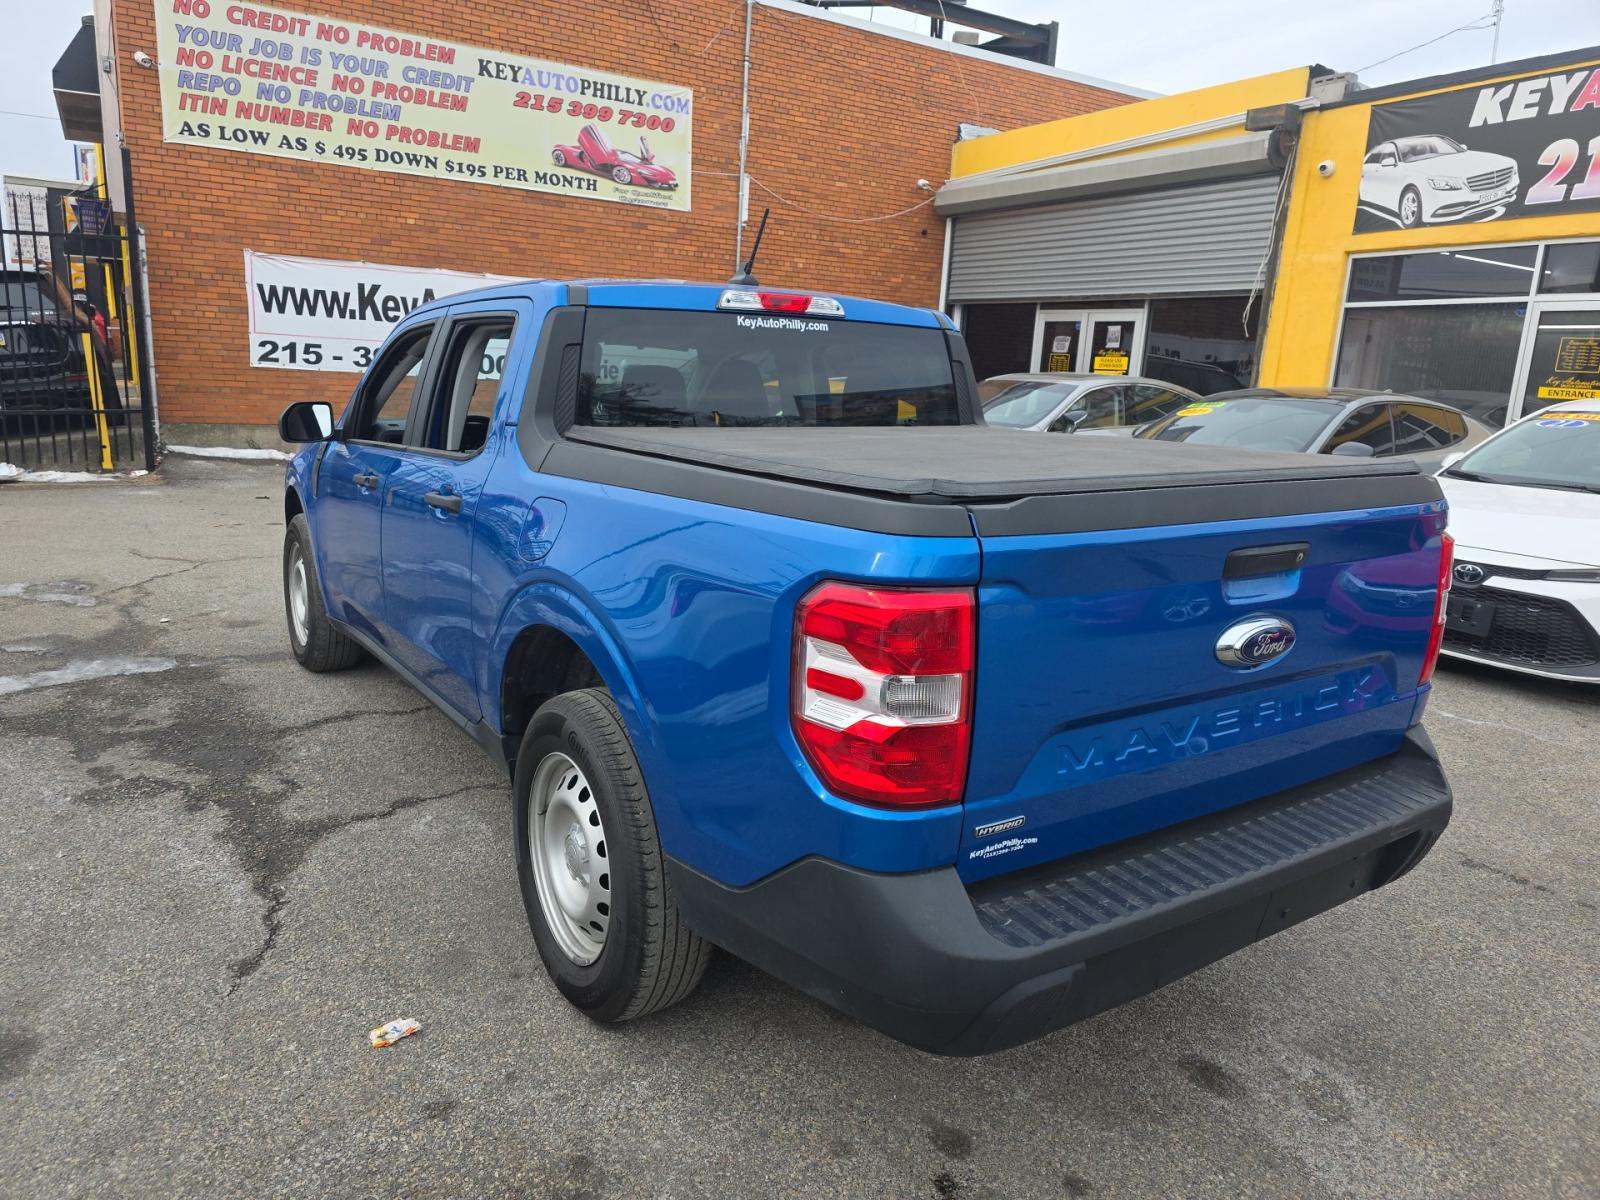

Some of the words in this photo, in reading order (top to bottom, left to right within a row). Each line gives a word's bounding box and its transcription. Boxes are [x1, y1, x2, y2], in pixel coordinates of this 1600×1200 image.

[173, 0, 210, 18] NO
[226, 6, 310, 36] CREDIT
[316, 23, 349, 44] NO
[357, 30, 455, 64] PROBLEM
[175, 24, 243, 52] YOUR
[249, 38, 293, 61] JOB
[301, 47, 322, 66] IS
[330, 52, 389, 78] YOUR
[402, 66, 474, 93] CREDIT
[176, 47, 213, 69] NO
[222, 55, 318, 87] LICENCE
[332, 74, 364, 94] NO
[371, 80, 469, 112] PROBLEM
[177, 70, 241, 96] REPO
[256, 82, 291, 104] NO
[299, 90, 401, 121] PROBLEM
[477, 59, 690, 115] KEYAUTOPHILLY.COM
[513, 92, 564, 113] 215
[567, 100, 613, 122] 399
[618, 109, 676, 132] 7300
[179, 92, 228, 116] ITIN
[235, 101, 332, 131] NUMBER
[347, 118, 379, 138] NO
[385, 124, 481, 153] PROBLEM
[178, 121, 210, 138] AS
[218, 126, 270, 146] LOW
[278, 135, 308, 151] AS
[333, 144, 368, 161] 495
[375, 148, 438, 169] DOWN
[445, 160, 487, 178] $195
[493, 165, 528, 182] PER
[534, 172, 598, 192] MONTH
[737, 316, 829, 332] KeyAutoPhilly.com
[258, 340, 323, 365] 215
[1548, 389, 1595, 398] ENTRANCE
[1253, 632, 1287, 657] Ford
[1057, 673, 1372, 774] MAVERICK
[969, 838, 1038, 860] KeyAutoPhilly.com
[978, 819, 1023, 836] HYBRID
